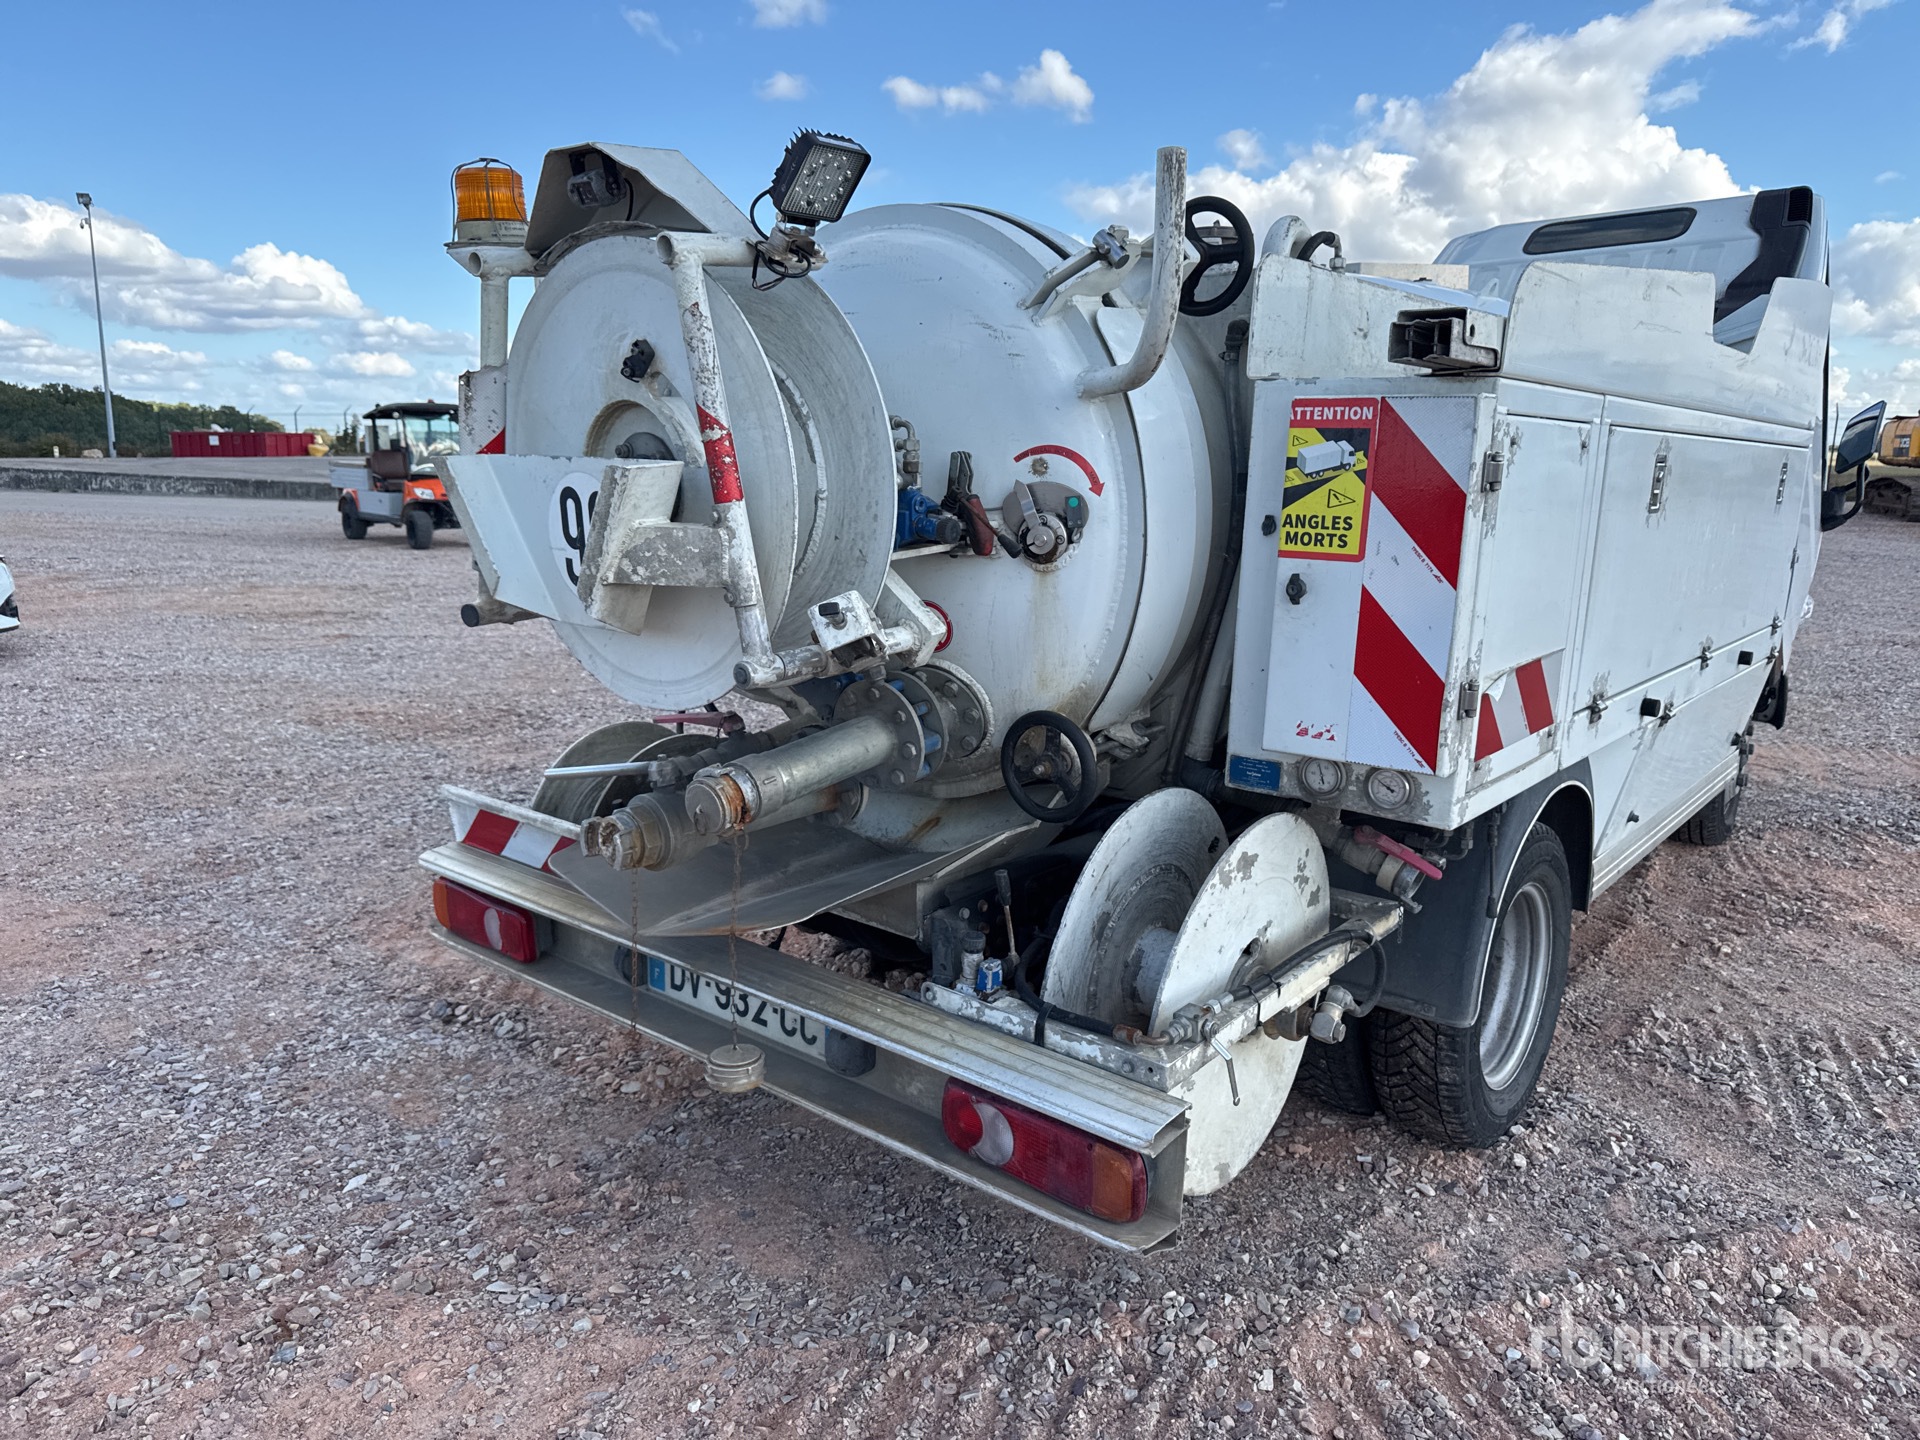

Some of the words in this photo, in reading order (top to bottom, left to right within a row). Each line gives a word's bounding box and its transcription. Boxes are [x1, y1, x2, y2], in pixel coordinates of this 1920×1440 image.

[1282, 513, 1353, 531] ANGLES
[560, 486, 599, 587] 9
[1284, 531, 1348, 549] MORTS
[654, 967, 660, 978] F
